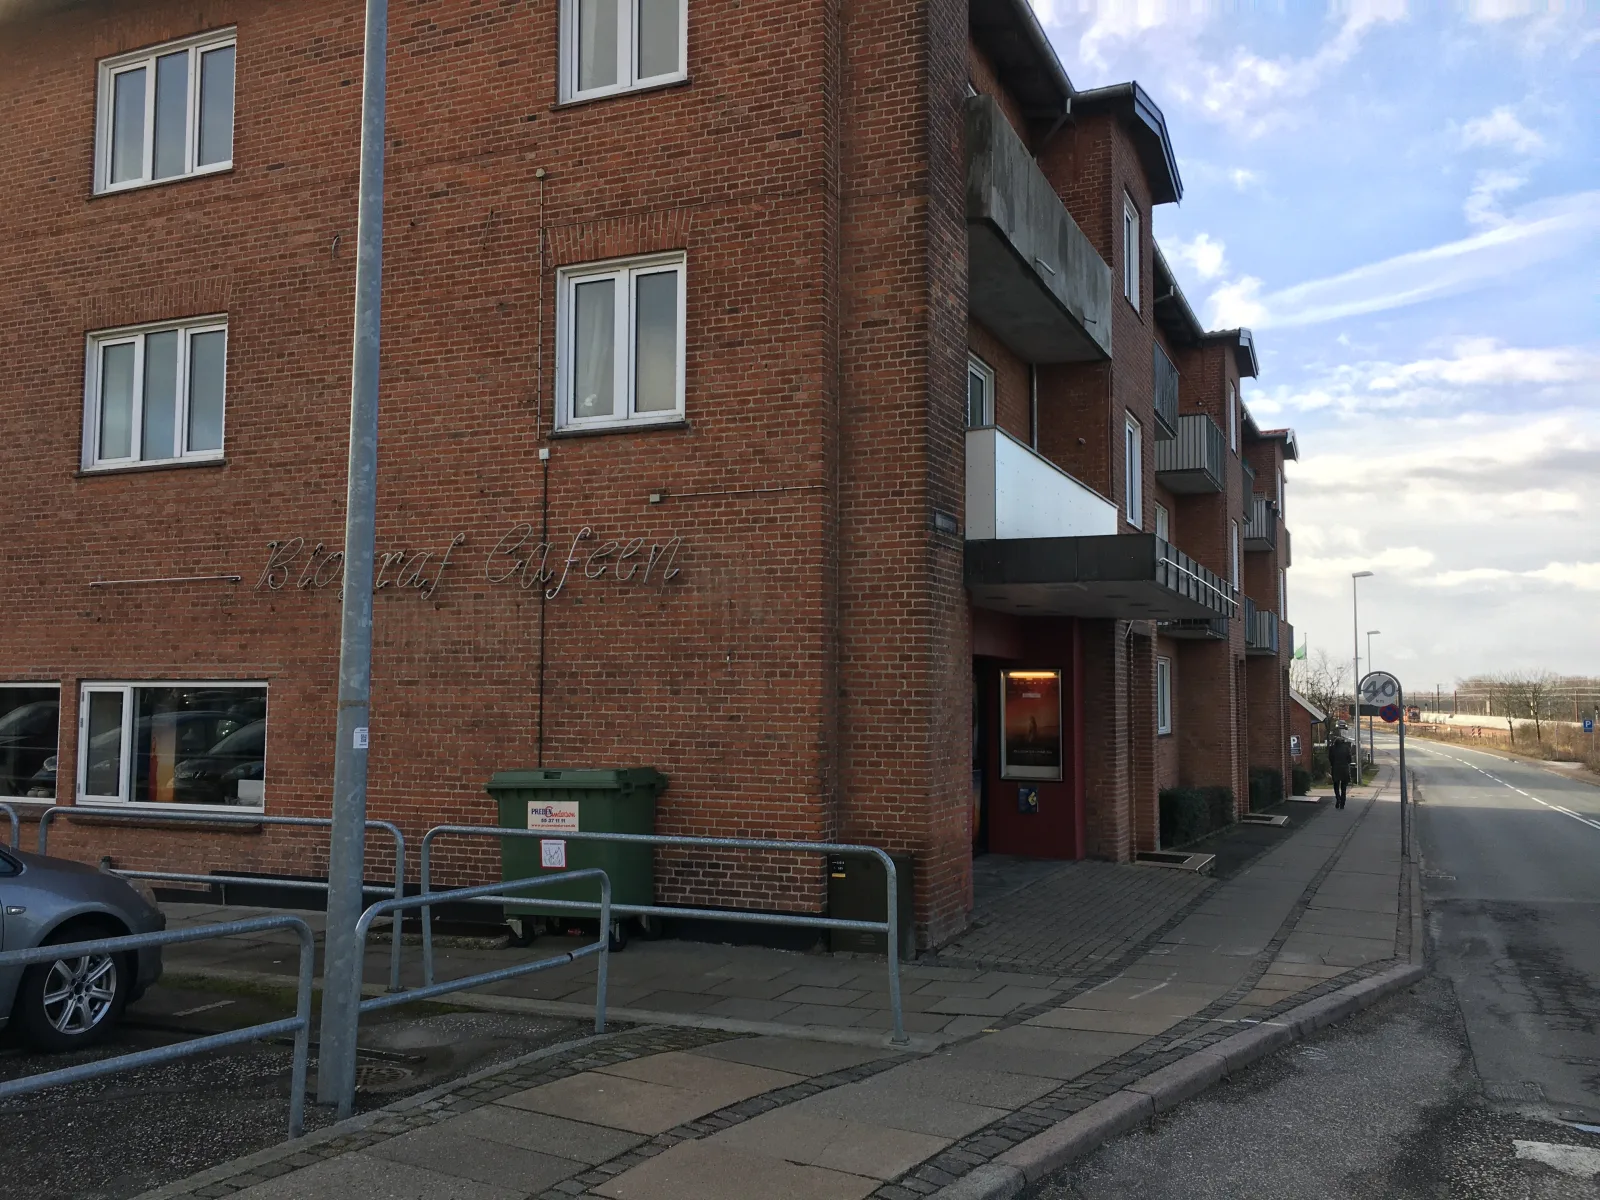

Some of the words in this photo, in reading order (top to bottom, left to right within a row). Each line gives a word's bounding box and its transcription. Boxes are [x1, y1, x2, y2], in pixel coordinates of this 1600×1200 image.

[254, 533, 465, 599] Bioraf
[486, 523, 682, 599] Cafeen
[1363, 680, 1396, 698] 40
[1290, 736, 1298, 748] P
